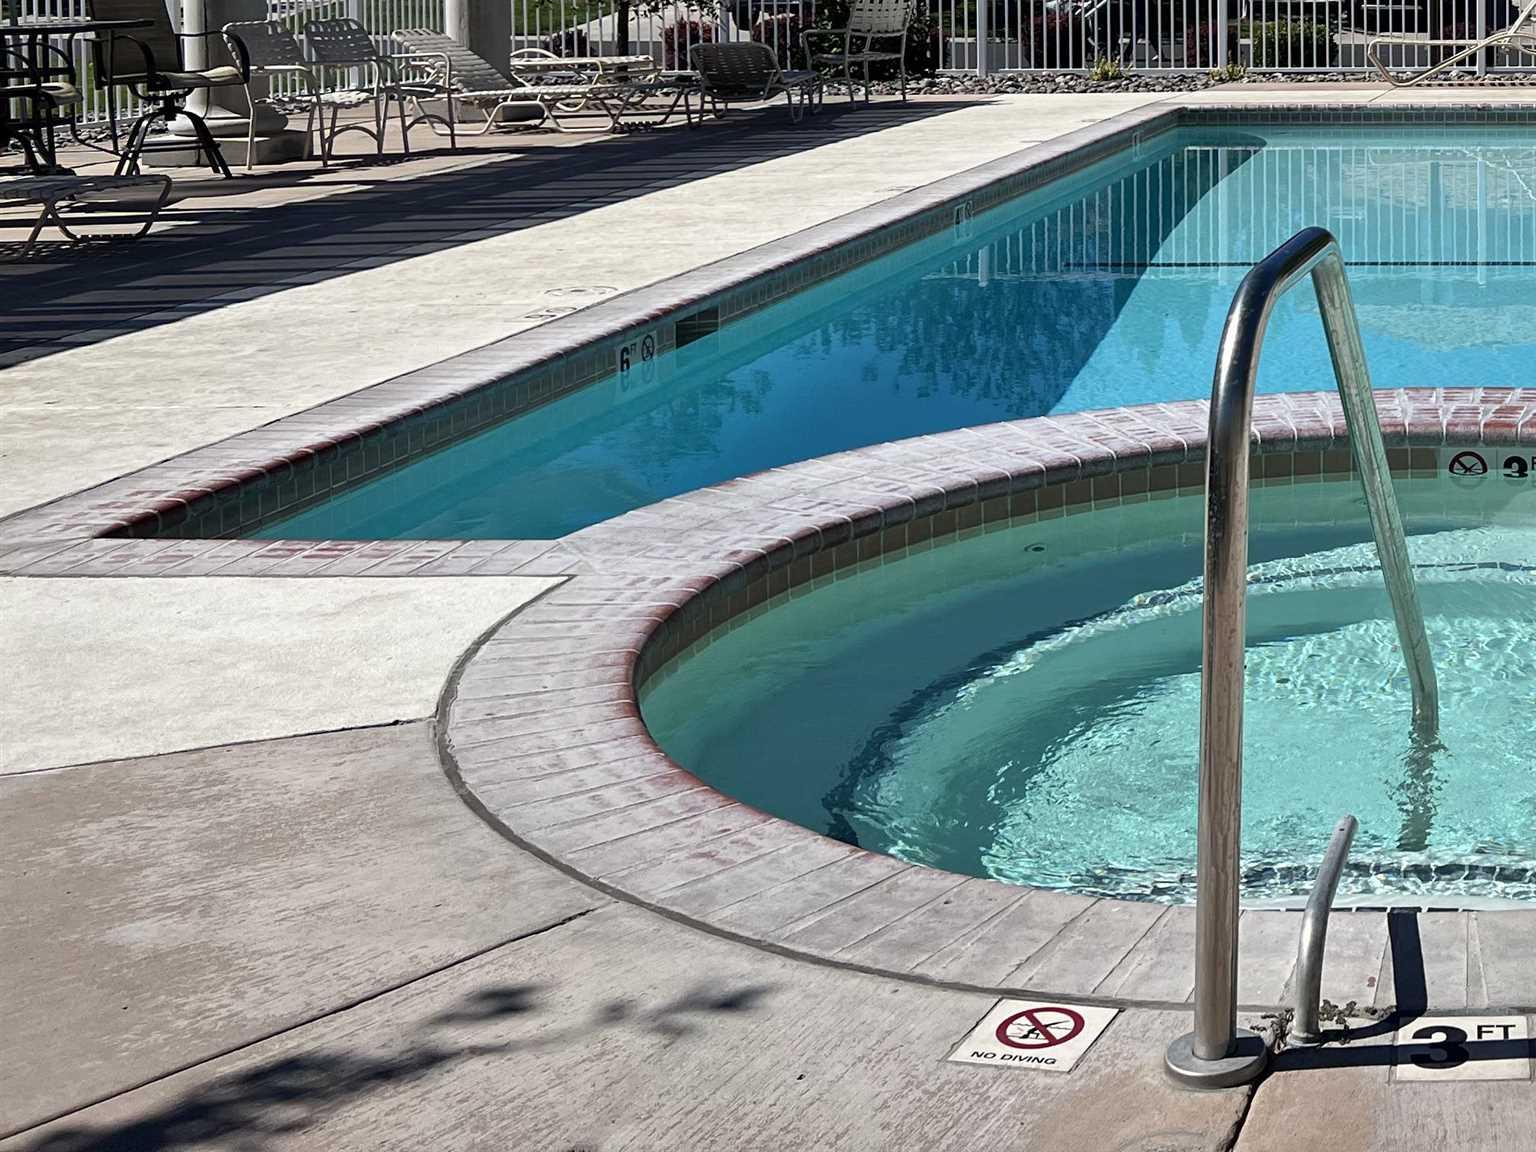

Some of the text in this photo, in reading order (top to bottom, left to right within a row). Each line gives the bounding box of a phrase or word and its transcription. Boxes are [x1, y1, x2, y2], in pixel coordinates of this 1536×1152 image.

[620, 347, 630, 372] 6
[1503, 456, 1528, 478] 3
[970, 1051, 1057, 1065] NO DIVING
[1410, 1024, 1516, 1069] 3 FT
